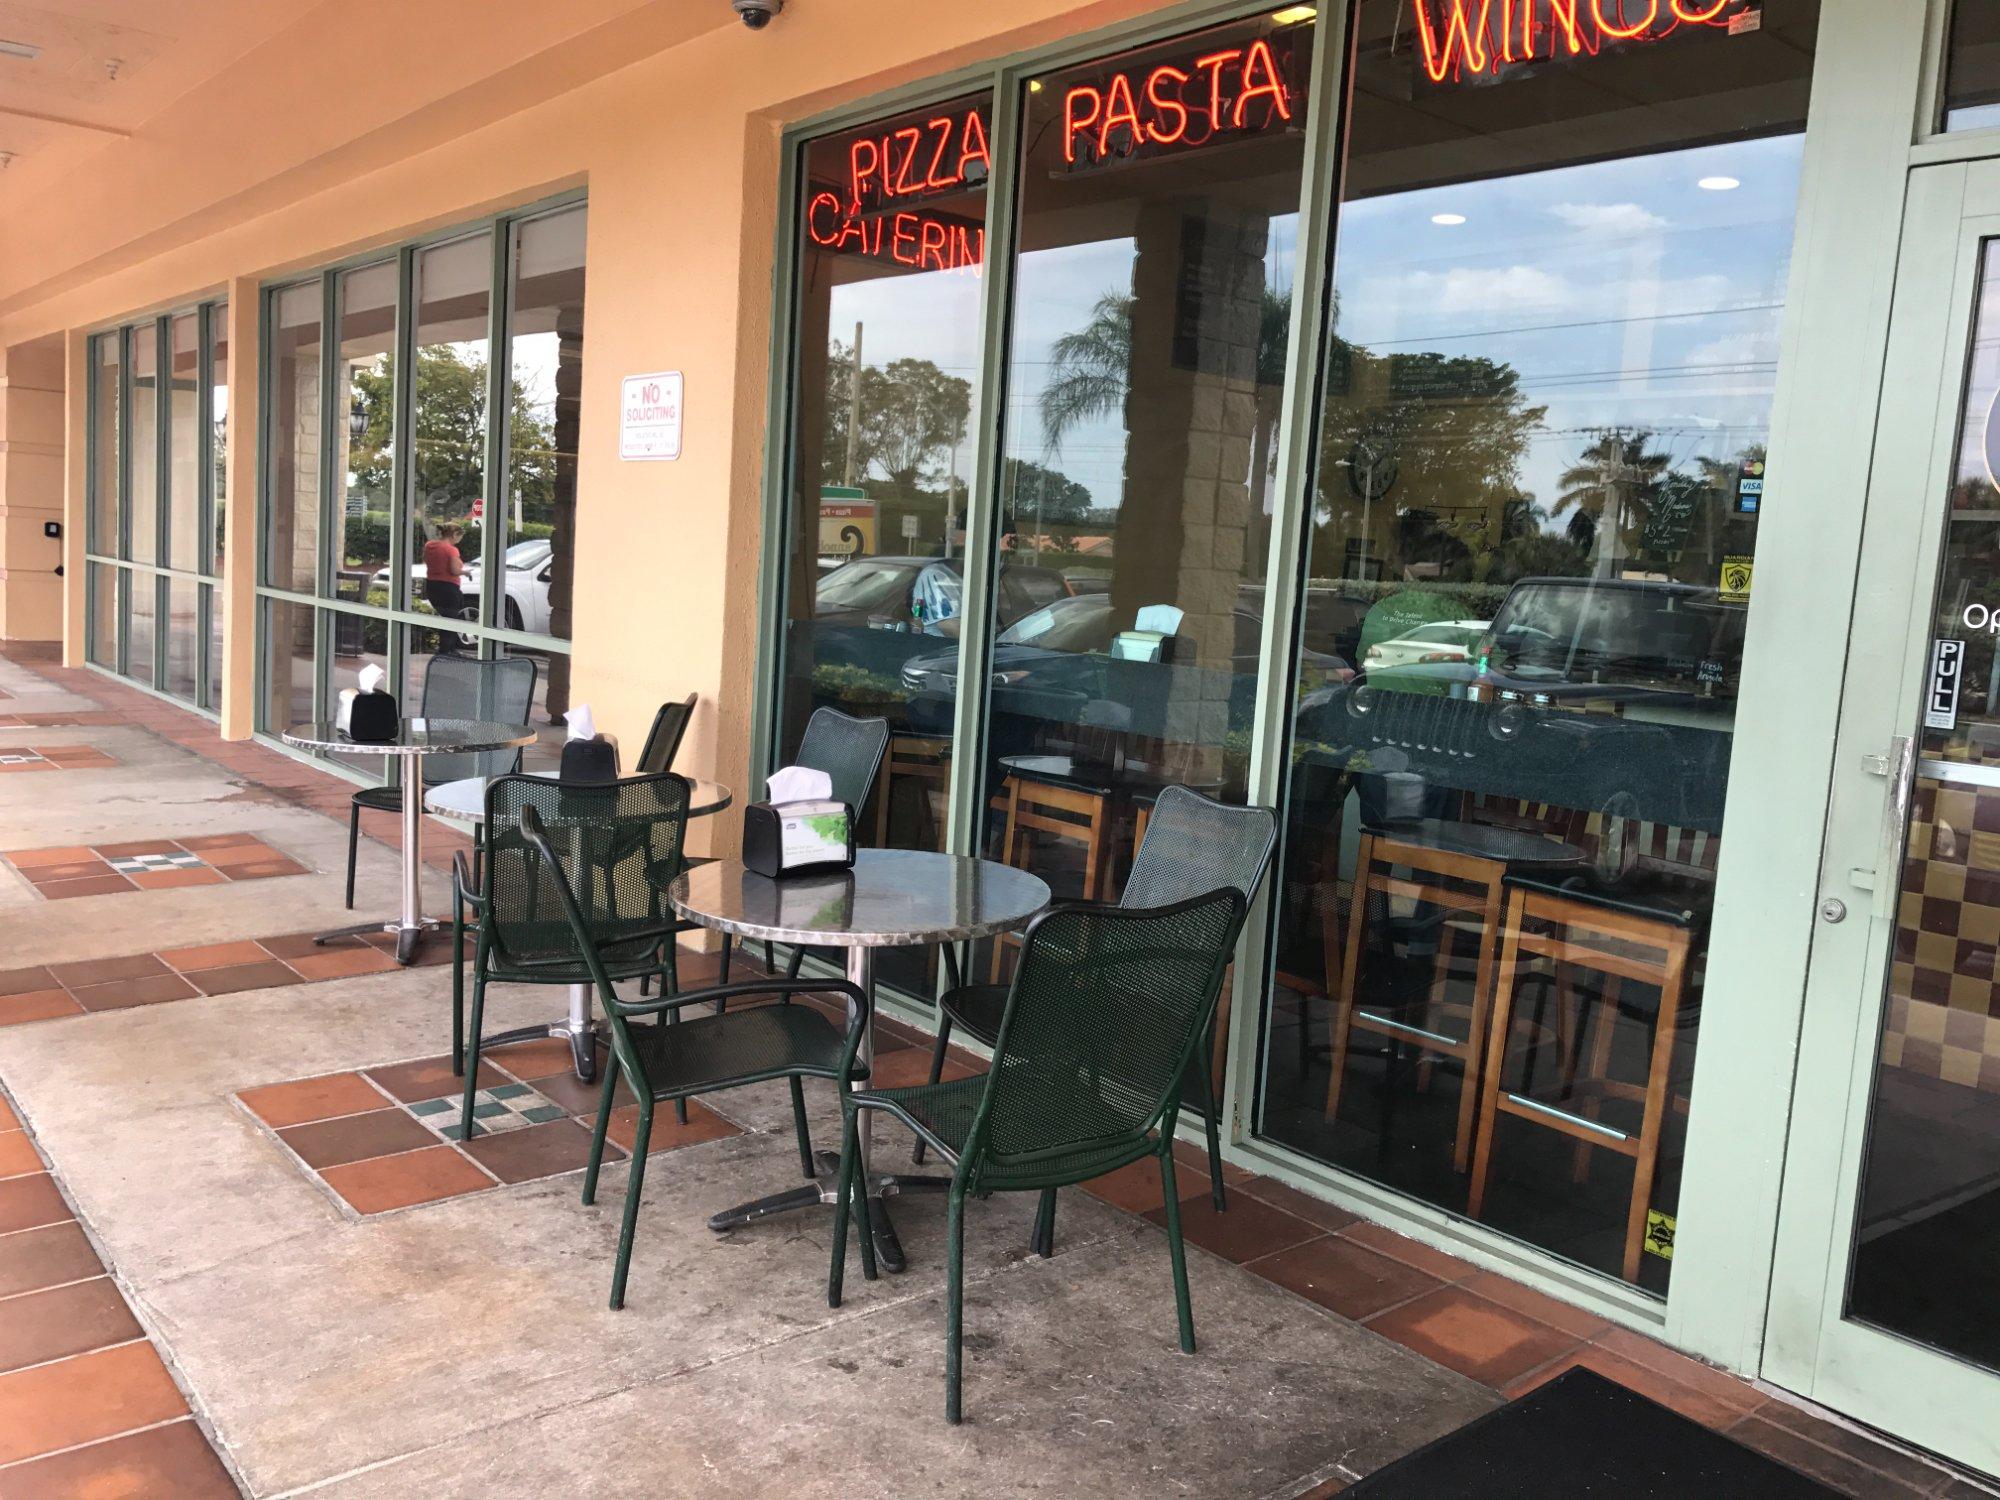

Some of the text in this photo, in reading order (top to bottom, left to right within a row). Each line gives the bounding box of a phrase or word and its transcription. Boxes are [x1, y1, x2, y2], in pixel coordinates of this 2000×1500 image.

[1413, 0, 1728, 82] WIN
[1064, 39, 1291, 162] PASTA
[851, 110, 990, 206] PIZZA
[626, 404, 675, 422] SOLICITING
[642, 384, 660, 405] NO
[1742, 482, 1762, 491] VISA
[1932, 642, 1959, 712] PULL
